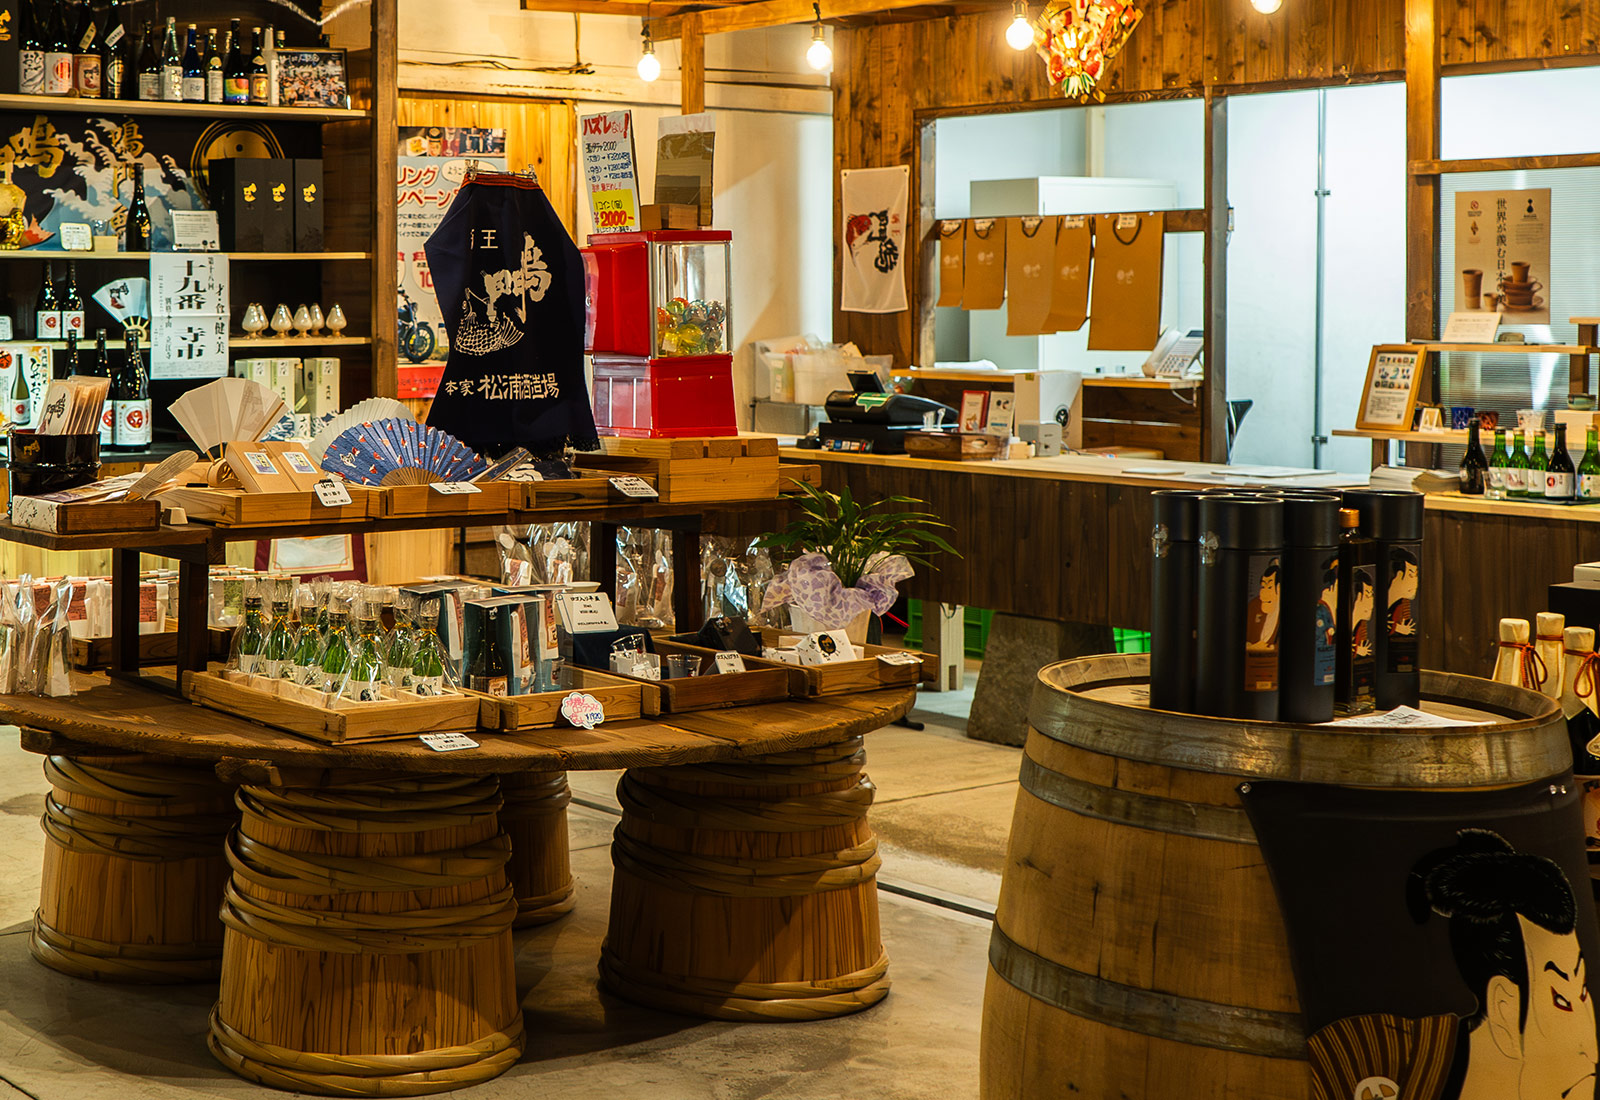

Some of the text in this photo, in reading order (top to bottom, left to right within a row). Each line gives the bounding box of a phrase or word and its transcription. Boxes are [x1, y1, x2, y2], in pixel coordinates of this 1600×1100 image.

[448, 166, 466, 176] ようこ
[173, 260, 207, 310] 十九番
[445, 373, 560, 400] 本家 松浦酒造場
